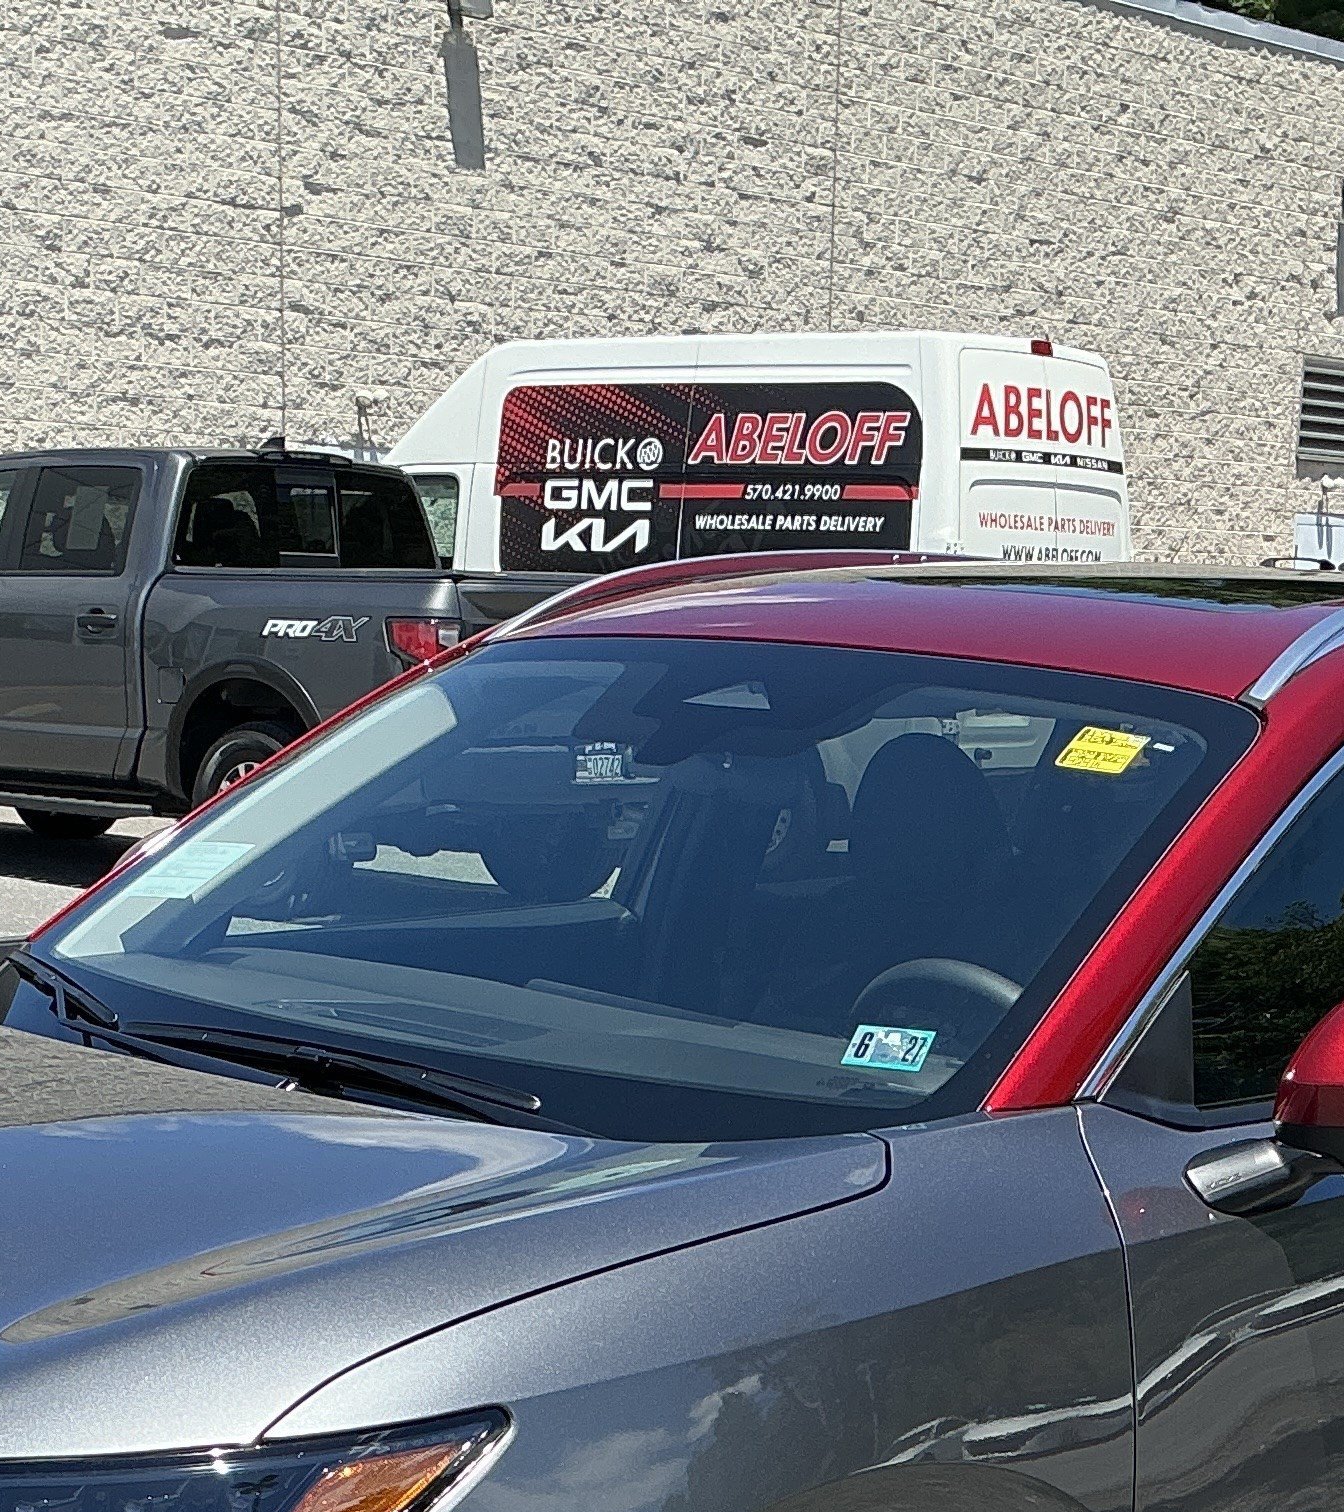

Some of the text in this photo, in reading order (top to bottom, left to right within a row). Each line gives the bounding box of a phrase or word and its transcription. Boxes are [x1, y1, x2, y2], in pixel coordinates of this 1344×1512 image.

[970, 383, 1112, 448] ABELOFF
[688, 411, 911, 466] ABELOFF
[546, 438, 636, 469] BUICK
[1076, 457, 1109, 470] NISSAN
[543, 479, 654, 511] GMC
[744, 484, 841, 501] 570.421.9900
[695, 514, 885, 532] WHOLESALE PARTS DELIVERY
[979, 512, 1116, 537] WHOLESALE PARTS DELIVERY
[1002, 545, 1102, 563] WWWABELOFFCOM
[854, 1032, 928, 1065] 6 27
